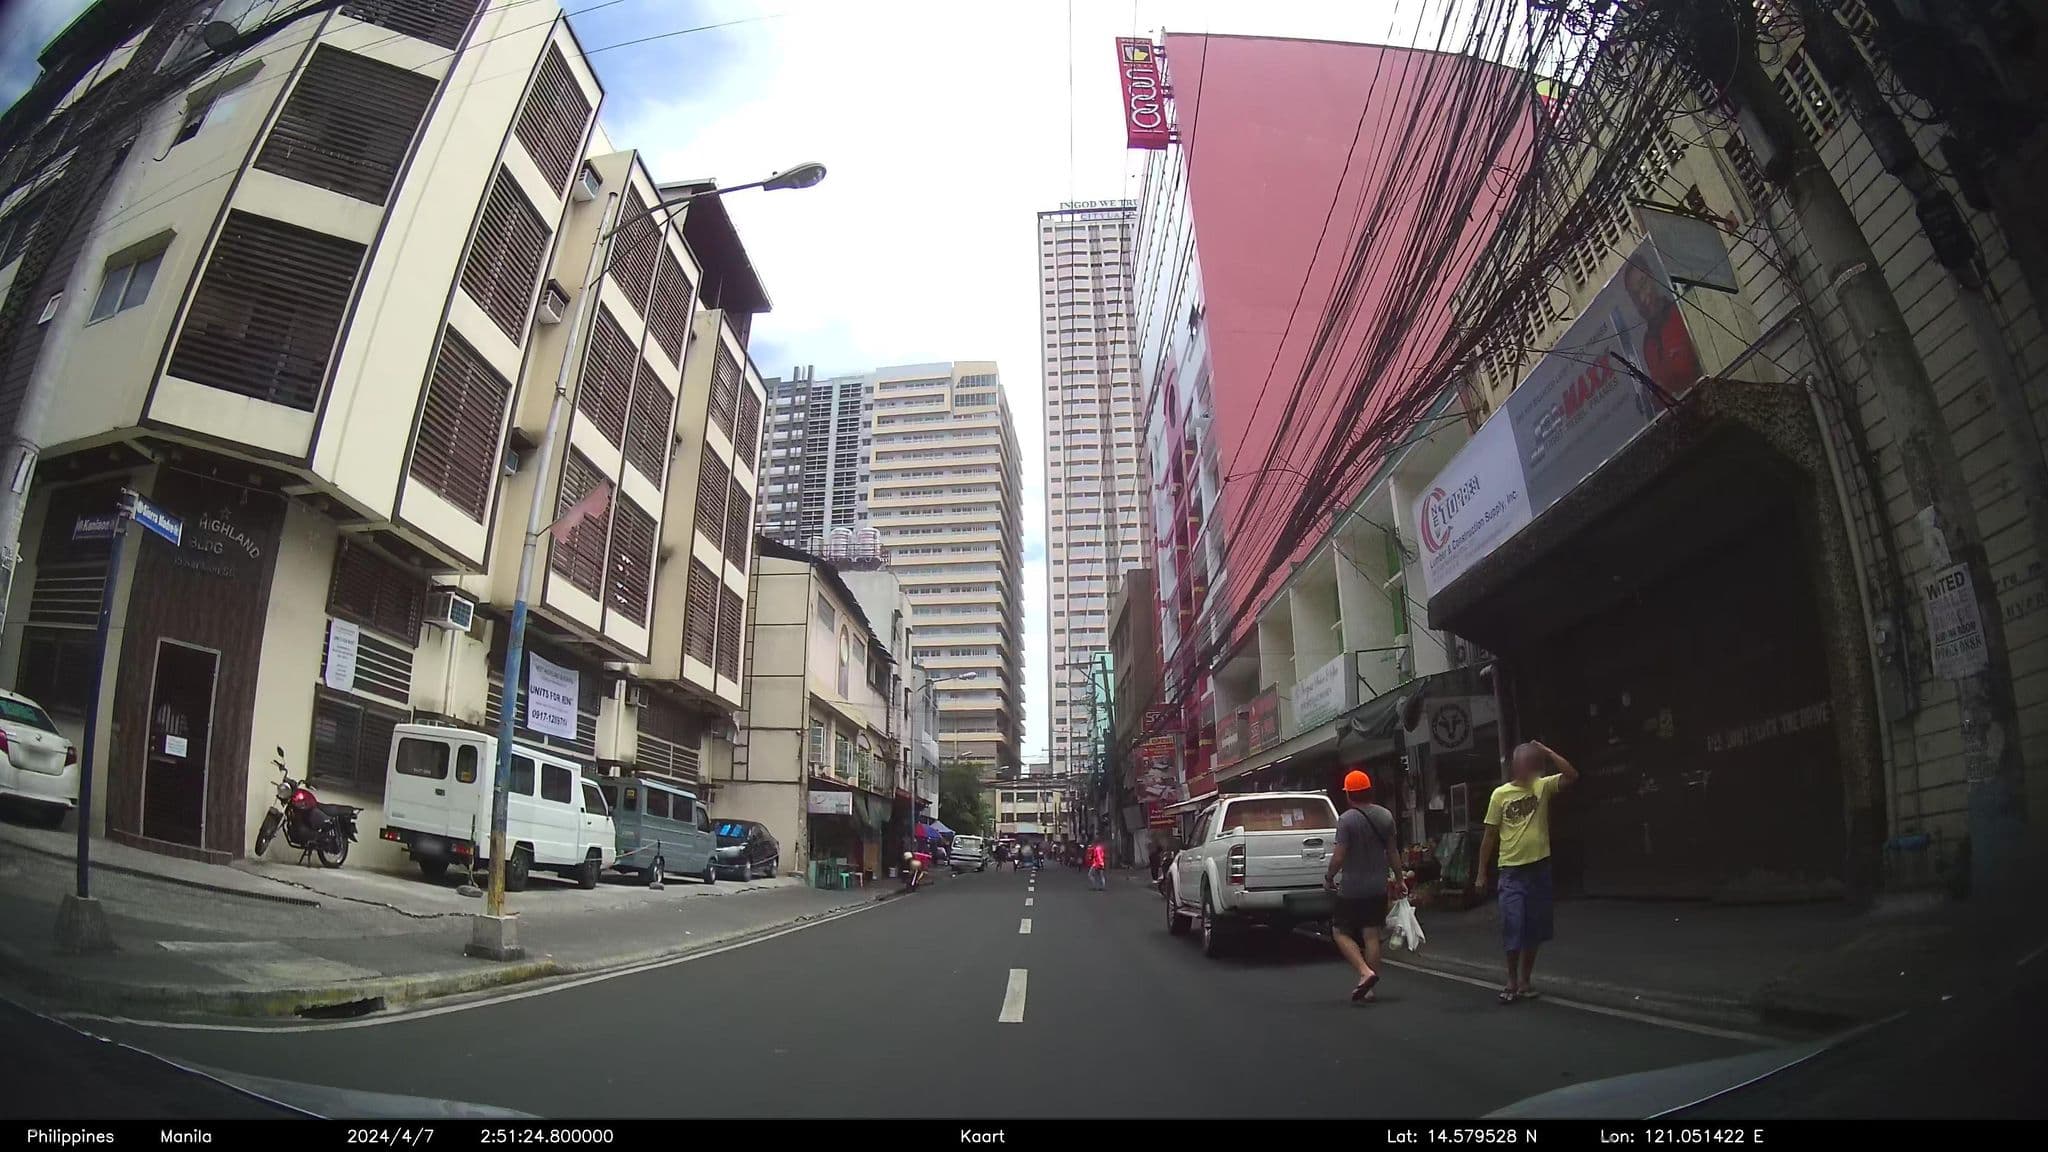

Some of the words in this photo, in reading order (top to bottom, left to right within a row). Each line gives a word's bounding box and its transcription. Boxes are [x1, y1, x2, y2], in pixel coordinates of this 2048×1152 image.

[1060, 201, 1074, 209] IN
[1074, 200, 1097, 209] GOD
[1100, 199, 1116, 207] WE
[200, 518, 260, 559] HIGHLAND
[1451, 515, 1484, 551] Construction
[191, 536, 223, 554] BLDG
[530, 684, 549, 699] UNITS
